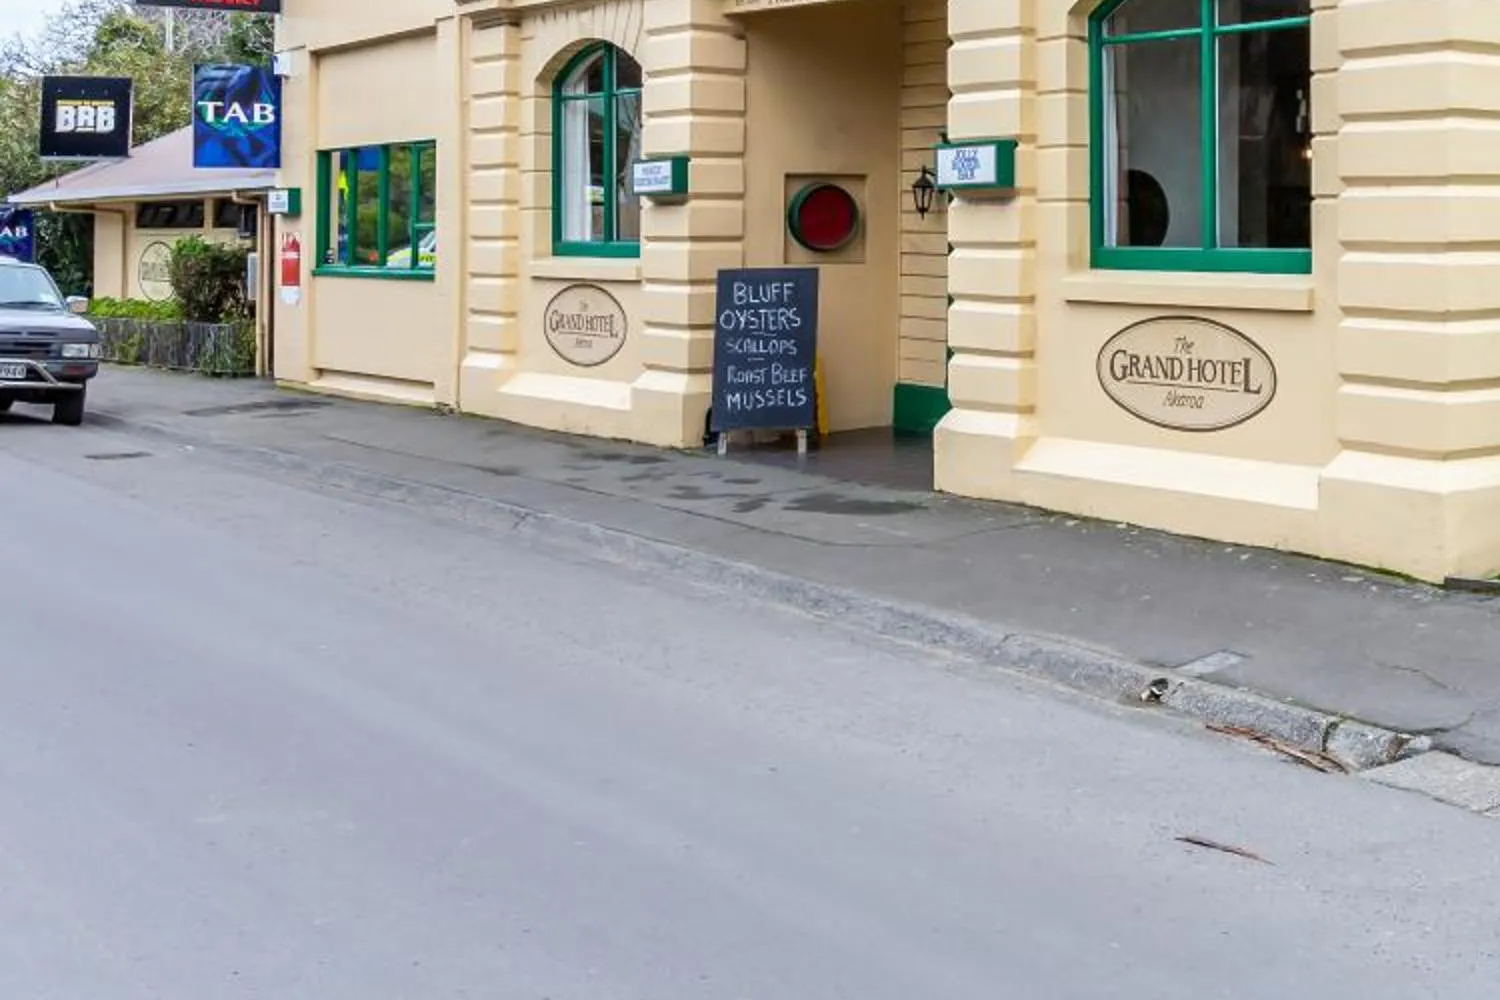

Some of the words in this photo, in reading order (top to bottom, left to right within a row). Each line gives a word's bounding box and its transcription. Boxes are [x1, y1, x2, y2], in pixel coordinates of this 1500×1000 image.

[198, 100, 276, 124] TAB
[733, 281, 796, 305] BLUFF
[719, 307, 801, 331] OYSTERS
[725, 337, 798, 356] SCALLOPS
[1174, 335, 1195, 355] The
[1109, 349, 1184, 382] GRAND
[1187, 357, 1263, 395] HOTEL
[727, 387, 808, 412] MUSSELS
